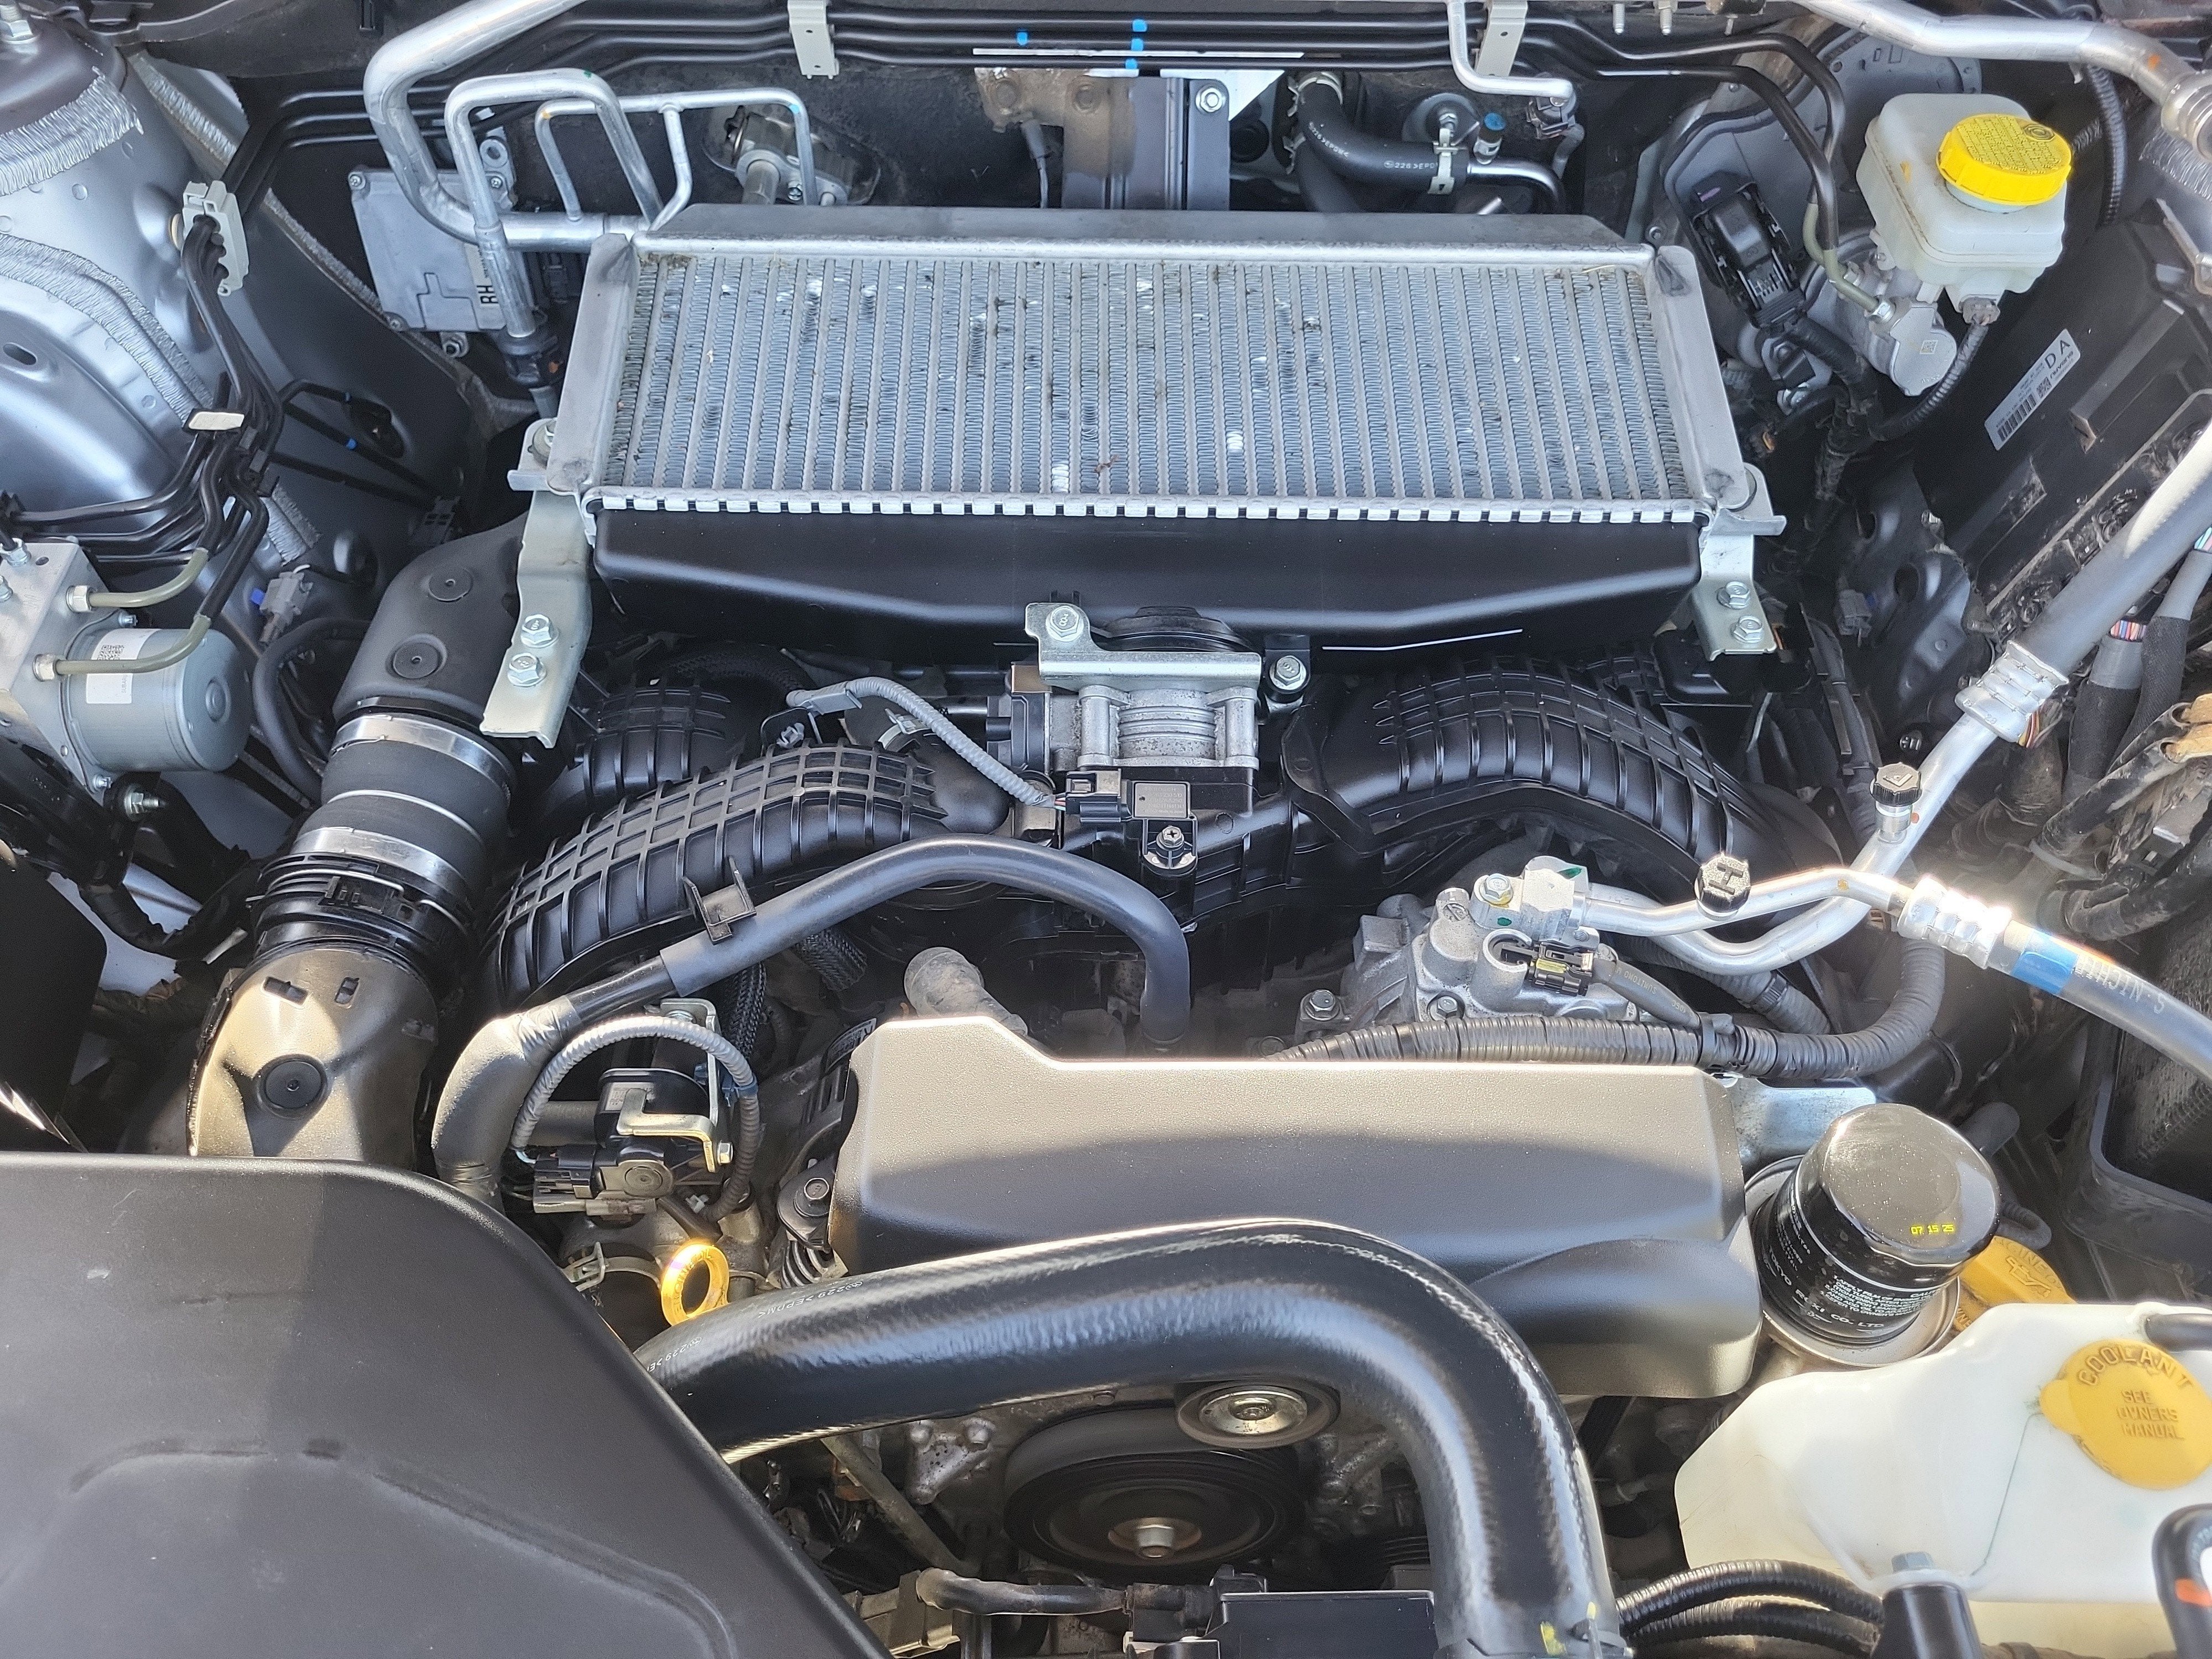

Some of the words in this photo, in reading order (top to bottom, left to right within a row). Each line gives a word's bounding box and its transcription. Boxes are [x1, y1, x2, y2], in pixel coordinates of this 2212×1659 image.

[476, 285, 499, 304] RH
[1708, 862, 1744, 895] H
[1911, 1226, 1923, 1234] 07
[1927, 1225, 1939, 1233] 15
[1769, 1244, 1792, 1286] TOKYO
[2077, 1345, 2193, 1388] COOLANT
[2121, 1389, 2153, 1405] SEE
[2116, 1406, 2178, 1422] OWNERS
[2121, 1422, 2185, 1441] MANUAL
